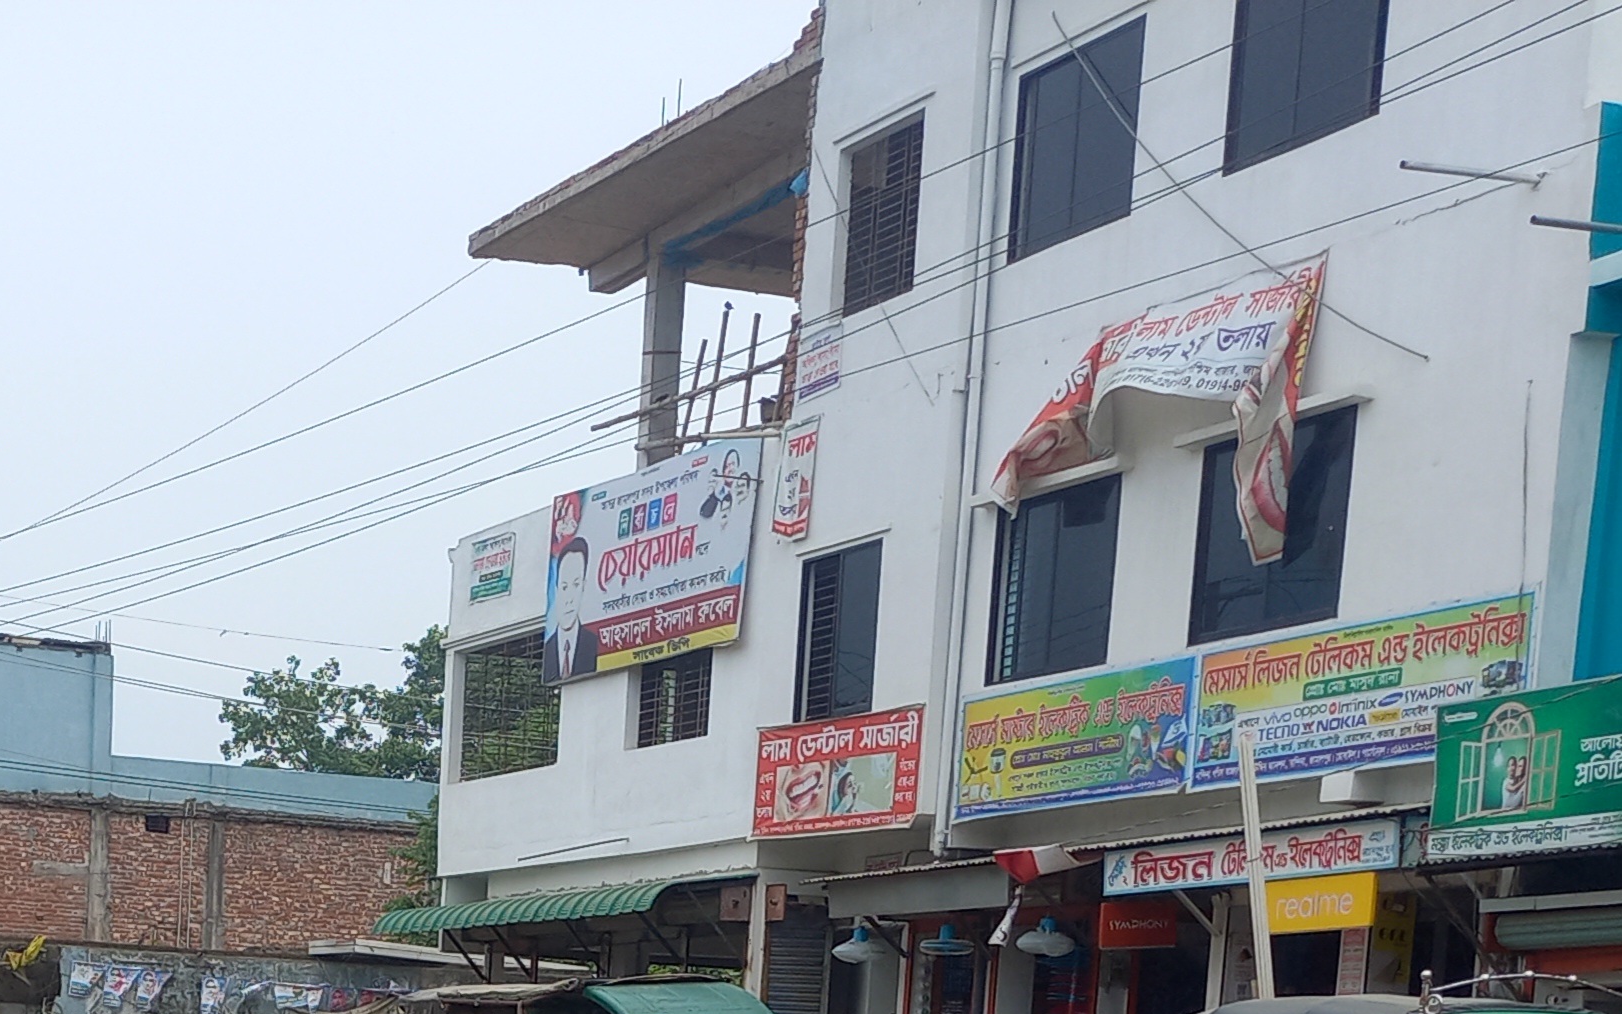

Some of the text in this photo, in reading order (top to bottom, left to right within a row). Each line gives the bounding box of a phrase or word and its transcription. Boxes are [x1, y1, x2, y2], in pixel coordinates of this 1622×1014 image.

[1216, 320, 1277, 351] তলায়
[788, 431, 818, 458] লাম
[598, 524, 698, 592] চেয়ারম্যান
[654, 602, 695, 635] ইসলাম
[698, 594, 738, 624] রুবেল
[1204, 650, 1252, 695] মেসার্স
[1252, 649, 1302, 688] লিজন
[1305, 636, 1376, 678] টেলিকম
[1263, 711, 1292, 726] vivo
[1293, 703, 1328, 719] oppo
[1404, 679, 1475, 703] SYMPHONY
[761, 710, 920, 763] লাম ডেন্টাল সার্জারী
[1258, 723, 1300, 742] TECNO
[1316, 713, 1368, 733] NOKIA
[1131, 849, 1216, 888] লিজন
[1108, 917, 1170, 932] SYMPHONY
[1276, 890, 1354, 921] realme
